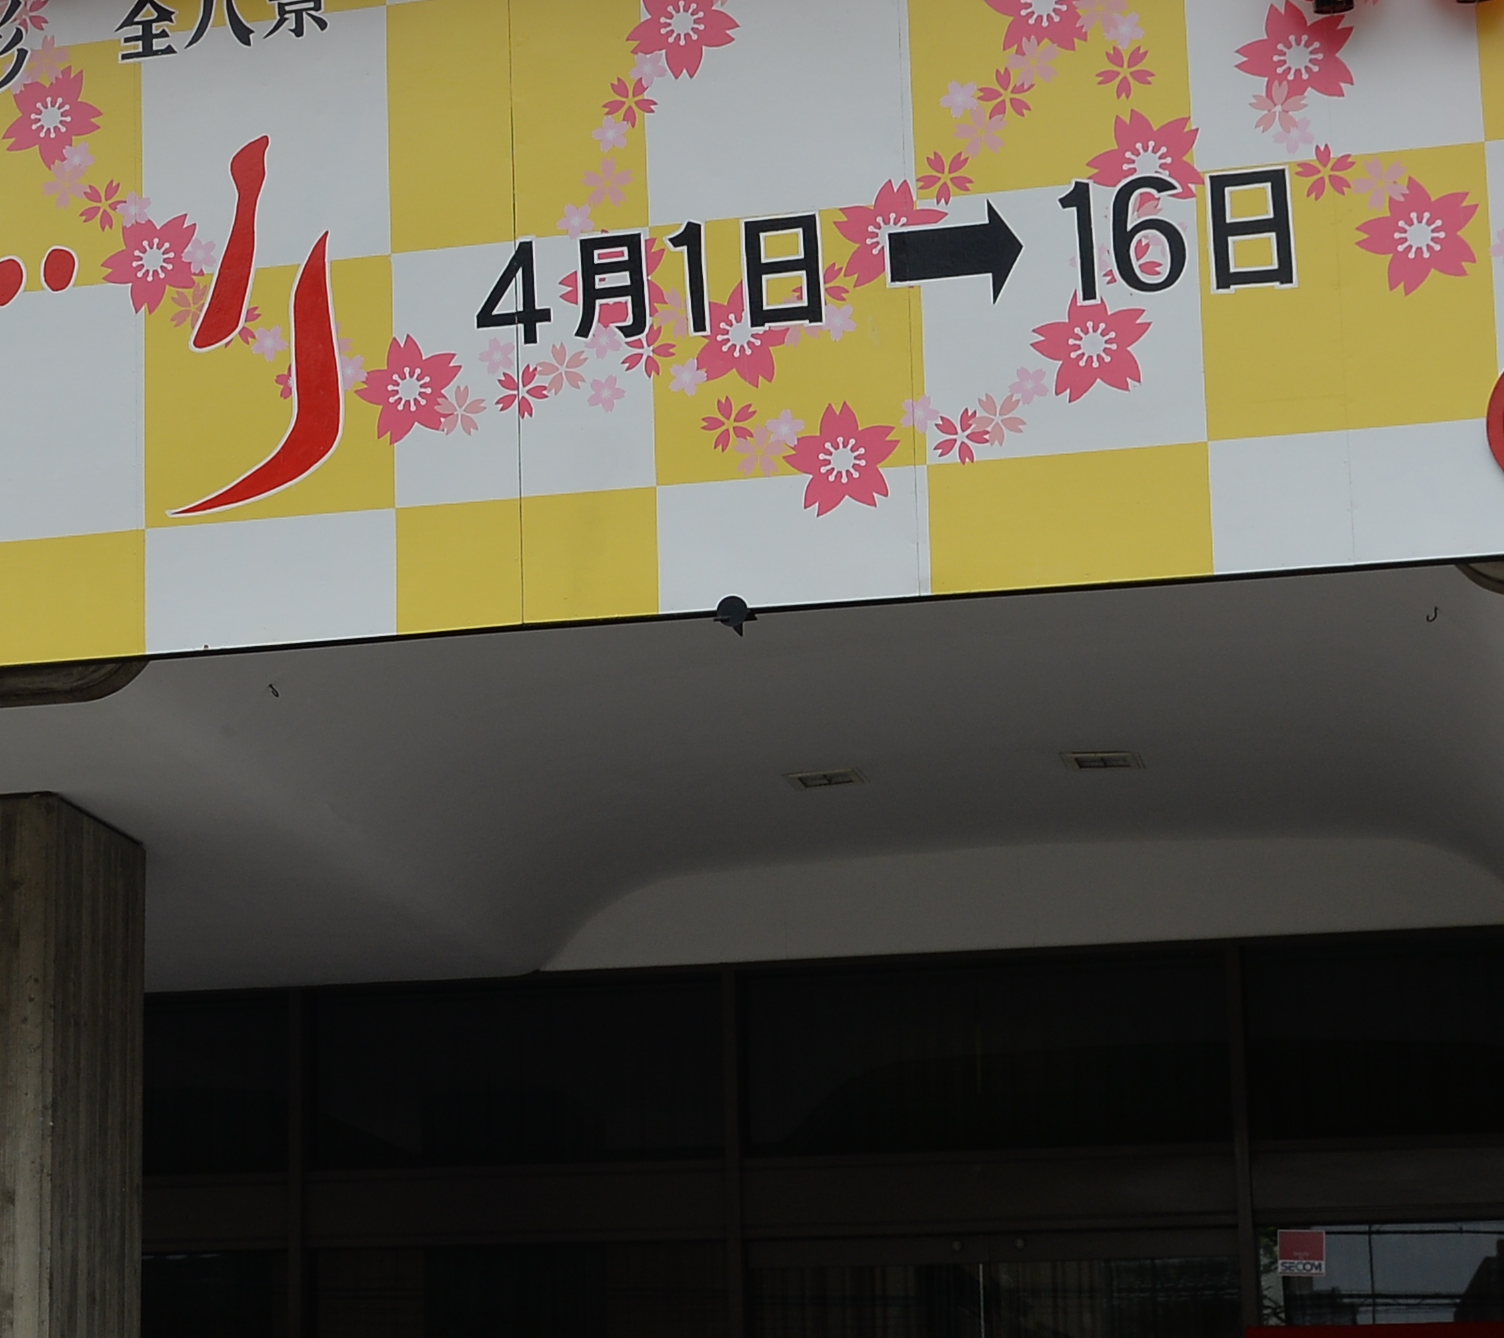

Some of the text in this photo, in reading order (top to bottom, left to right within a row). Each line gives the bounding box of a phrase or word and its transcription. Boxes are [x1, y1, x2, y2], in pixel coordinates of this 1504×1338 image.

[474, 165, 1301, 346] 4月1日 16日
[1280, 1261, 1322, 1272] SECOM
